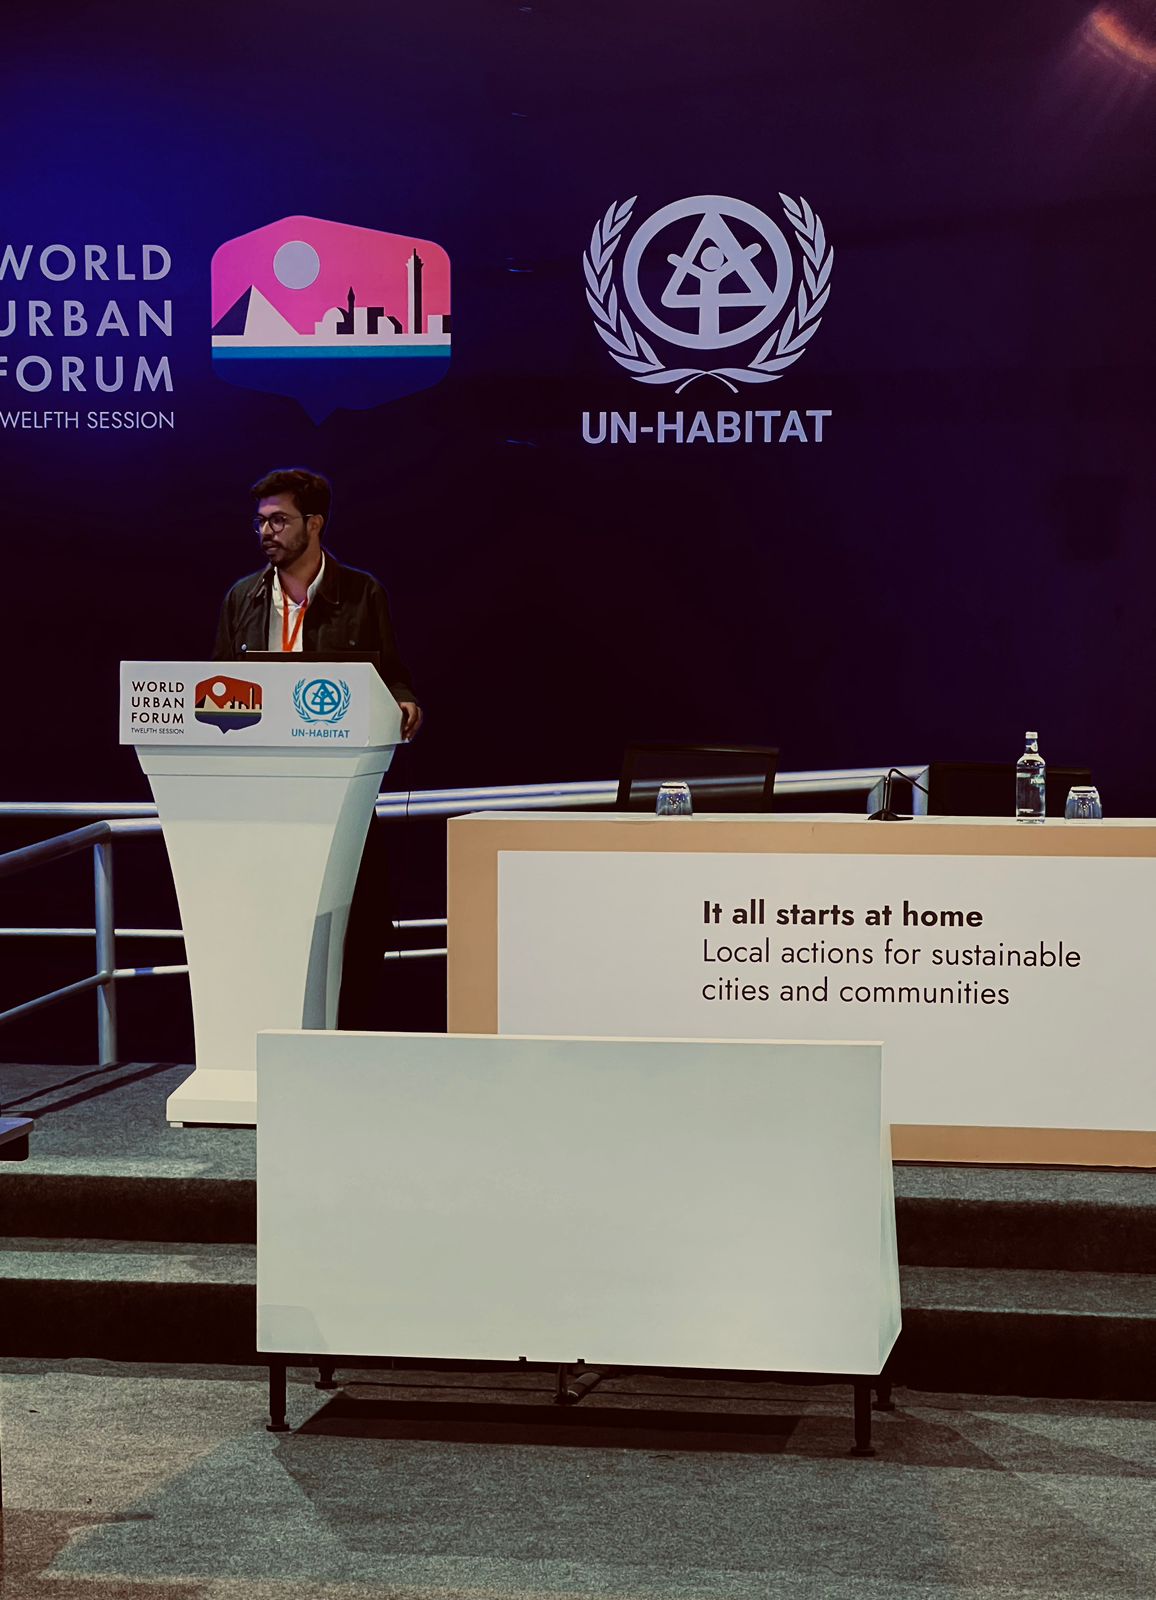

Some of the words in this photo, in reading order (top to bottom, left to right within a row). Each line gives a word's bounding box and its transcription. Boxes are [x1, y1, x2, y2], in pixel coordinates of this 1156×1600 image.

[0, 244, 172, 281] WORLD
[0, 411, 79, 428] WELFTH
[87, 411, 174, 428] SESSION
[582, 410, 832, 444] UN-HABITAT
[131, 681, 184, 692] WORLD
[131, 696, 184, 708] URBAN
[131, 712, 184, 724] FORUM
[291, 728, 350, 739] UN-HABITAT
[703, 901, 723, 924] It
[732, 899, 765, 925] all
[776, 904, 855, 926] starts
[864, 905, 893, 926] at
[903, 901, 983, 928] home
[703, 937, 770, 963] Local
[781, 940, 874, 965] actions
[884, 939, 922, 965] for
[931, 941, 1081, 968] sustainable
[702, 977, 770, 1001] cities
[779, 976, 828, 1002] and
[839, 980, 1010, 1005] communities
